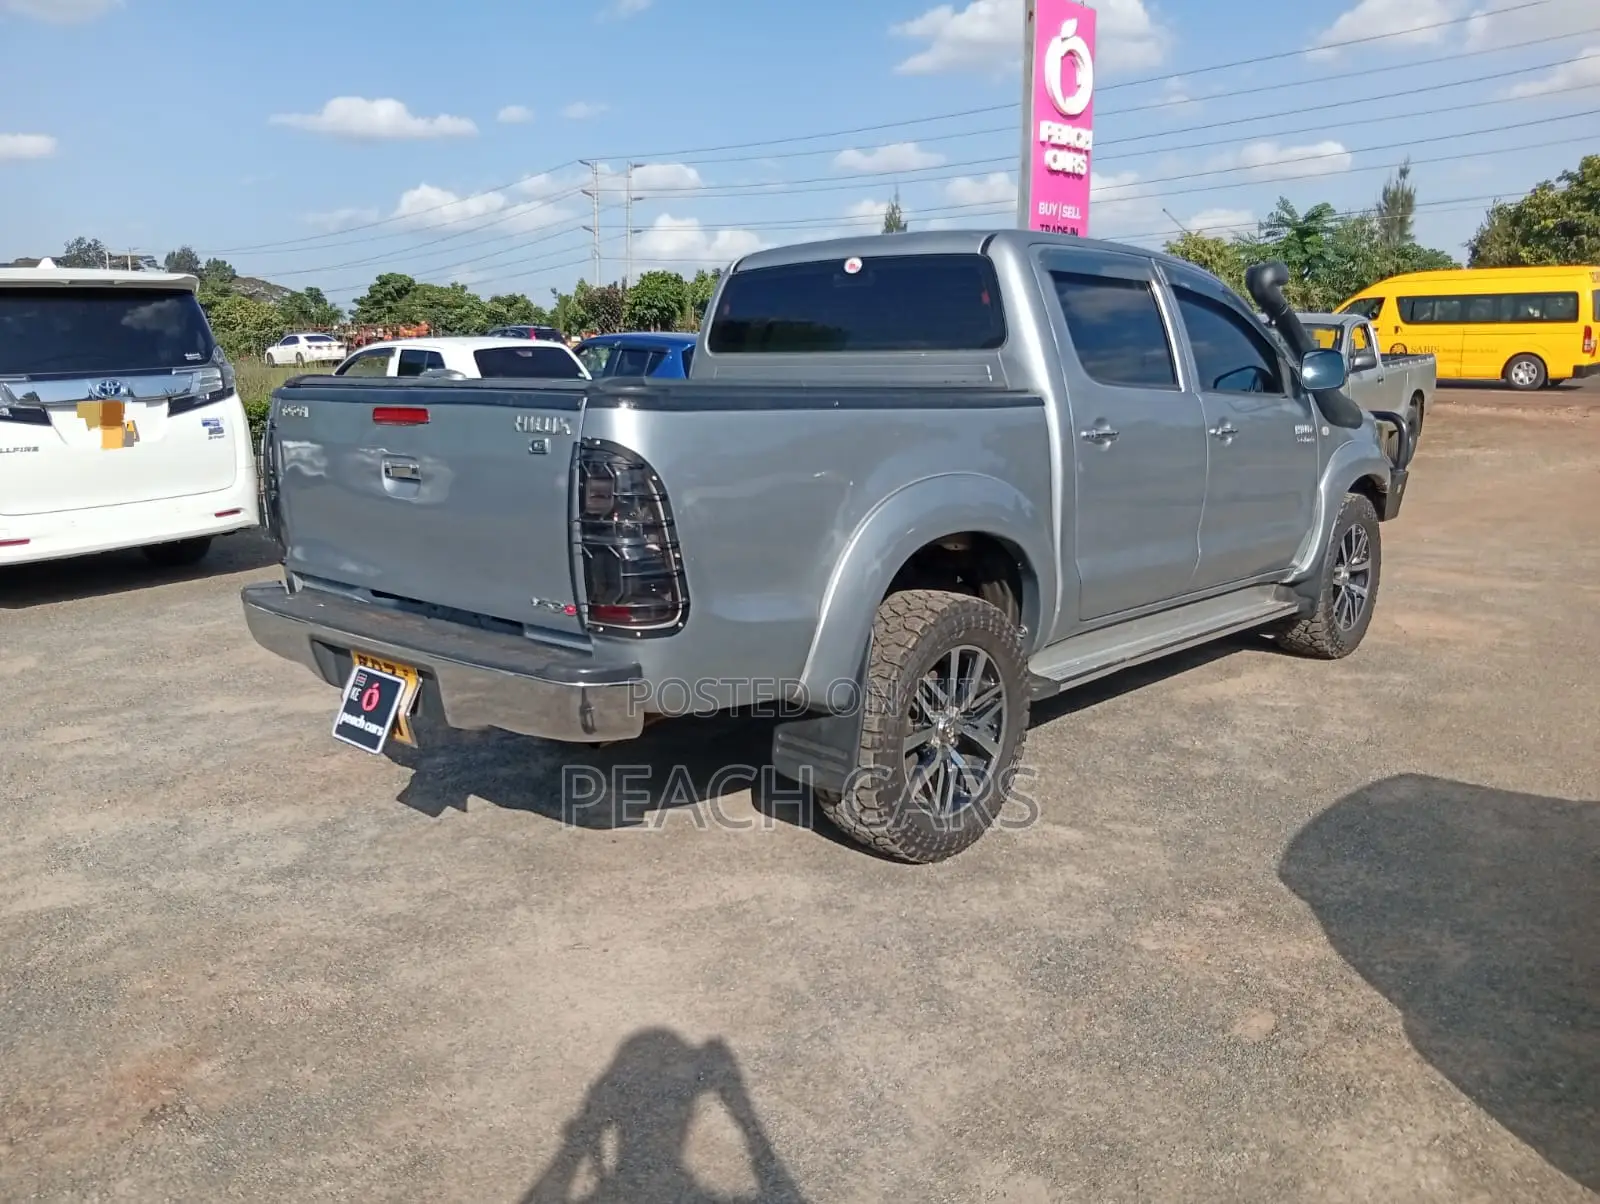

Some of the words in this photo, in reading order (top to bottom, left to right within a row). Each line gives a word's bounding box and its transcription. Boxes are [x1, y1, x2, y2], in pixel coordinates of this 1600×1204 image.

[1044, 149, 1087, 176] CARS
[1038, 201, 1058, 216] BUY
[1062, 204, 1082, 219] SELL
[338, 712, 365, 731] peach
[364, 723, 385, 737] cars
